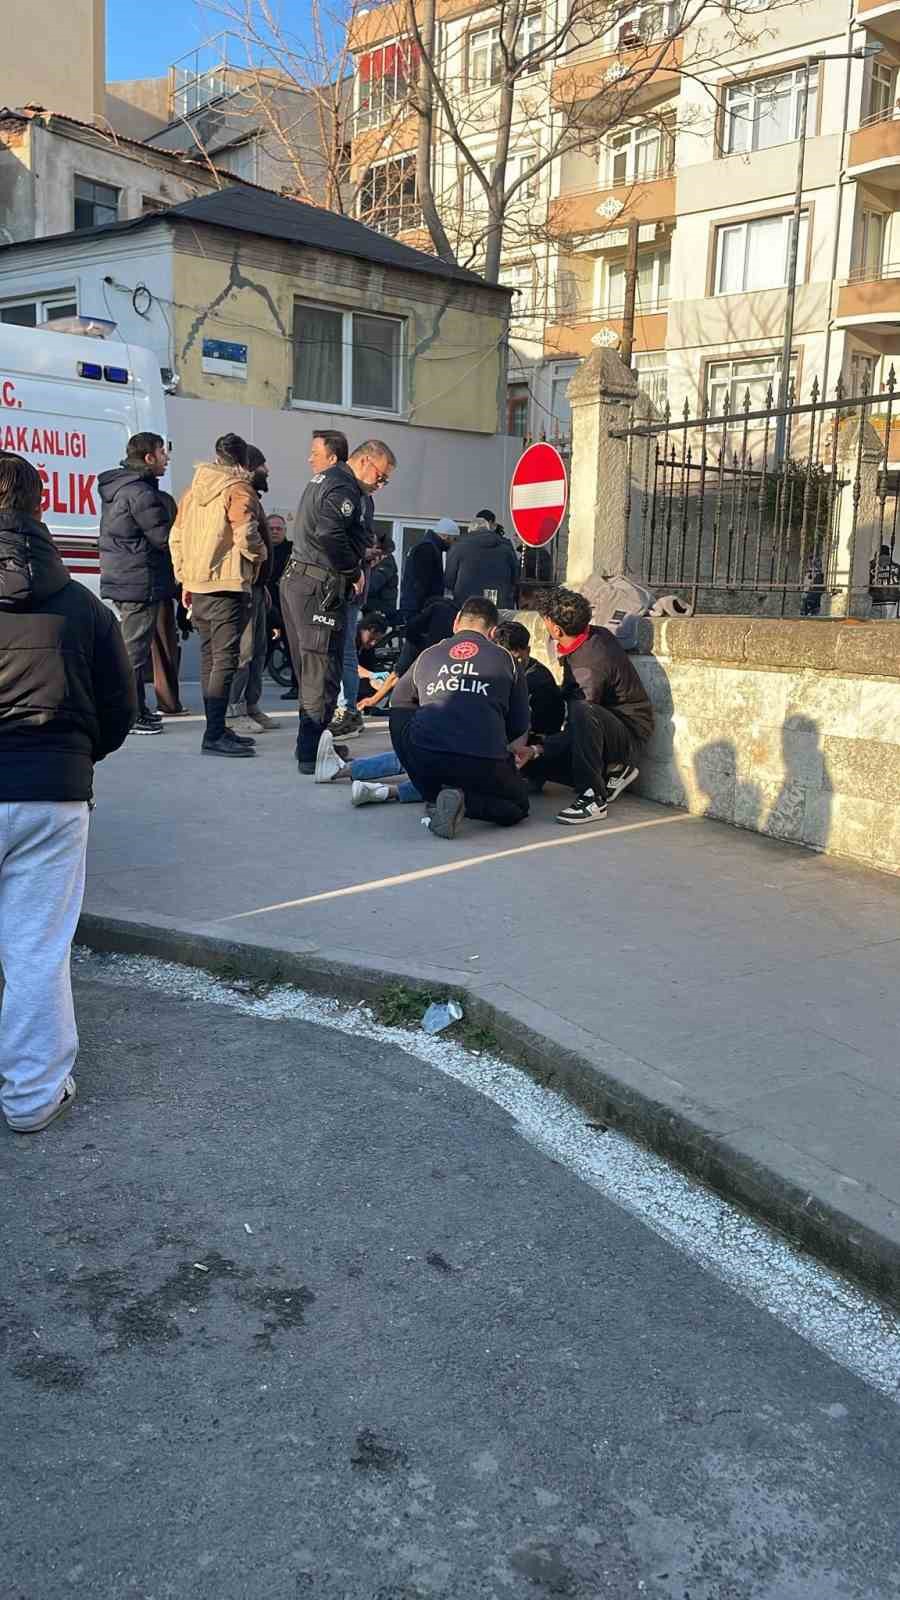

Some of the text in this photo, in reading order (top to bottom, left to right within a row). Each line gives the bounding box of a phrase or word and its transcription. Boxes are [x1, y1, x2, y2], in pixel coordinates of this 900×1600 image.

[0, 424, 87, 459] AKANLIĞI
[37, 463, 97, 515] ĞLIK
[437, 661, 480, 677] ACİL
[425, 675, 491, 697] SAĞLIK
